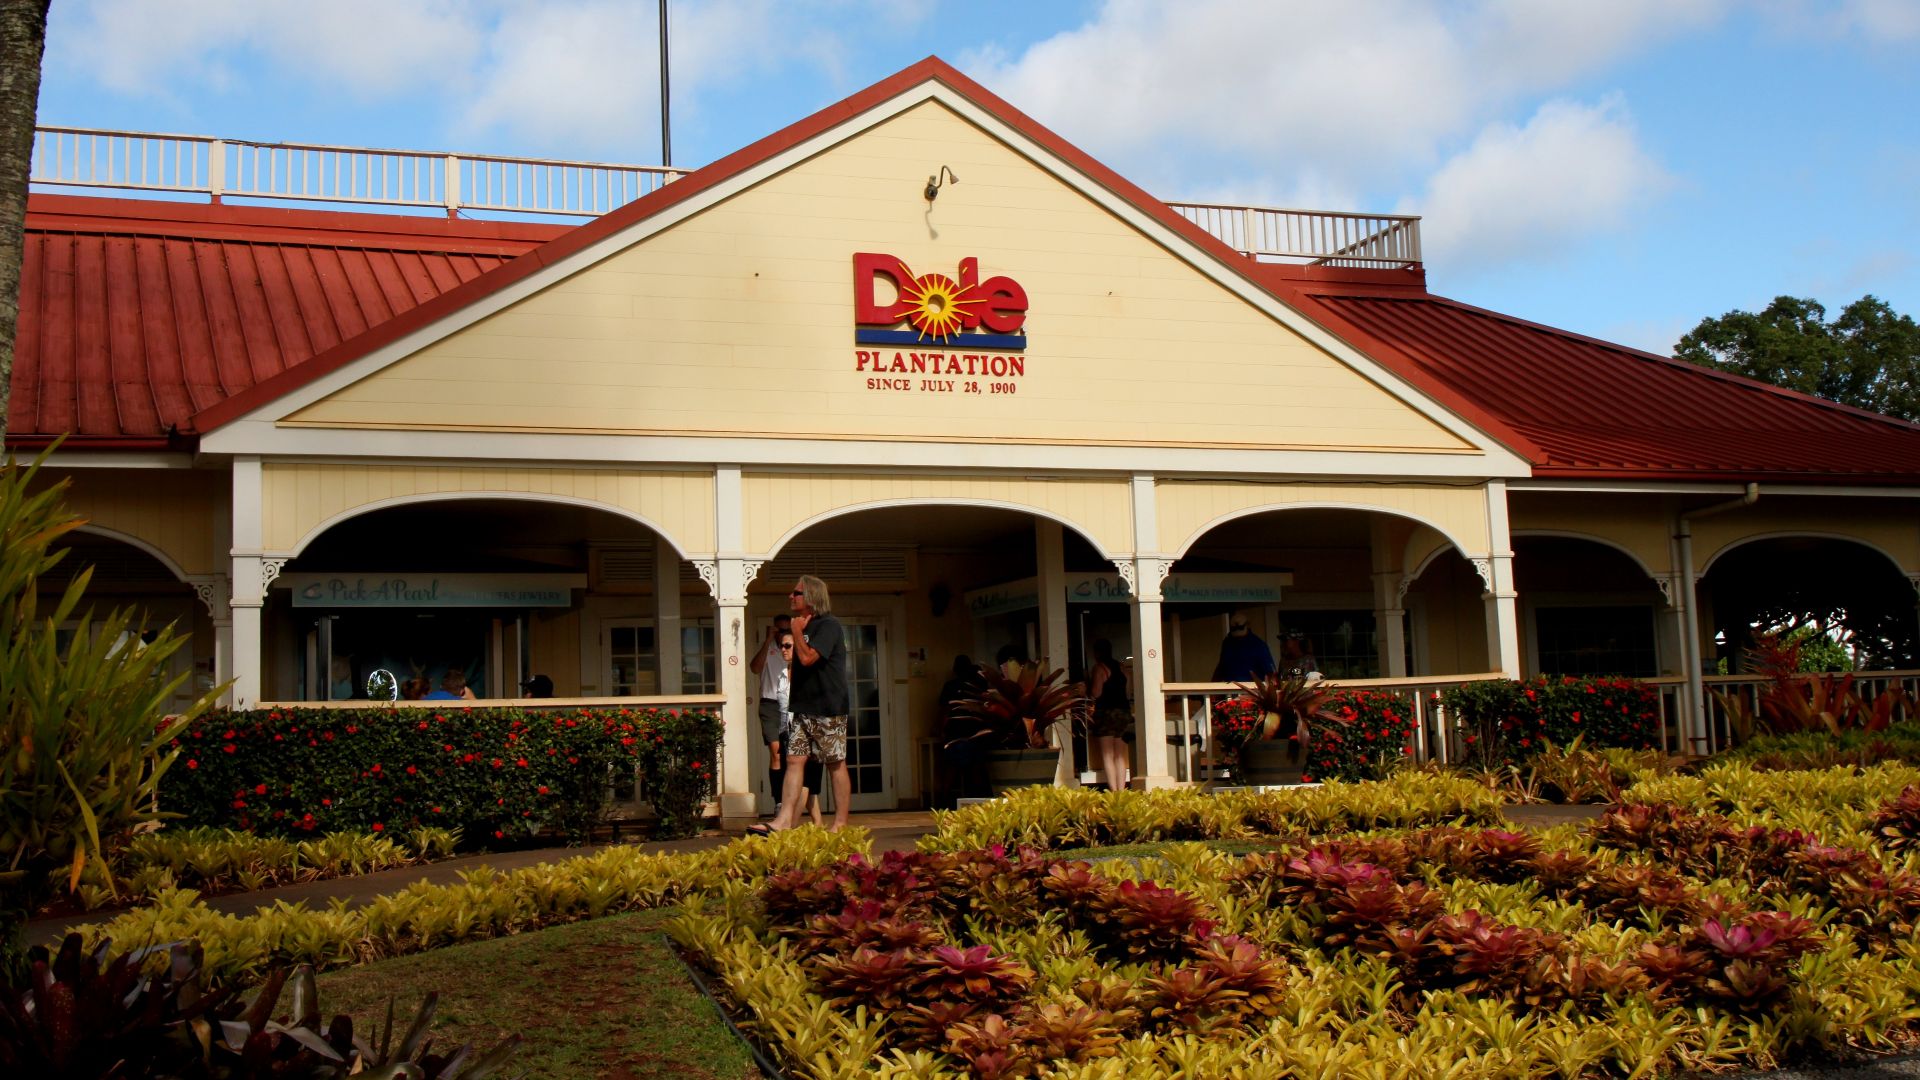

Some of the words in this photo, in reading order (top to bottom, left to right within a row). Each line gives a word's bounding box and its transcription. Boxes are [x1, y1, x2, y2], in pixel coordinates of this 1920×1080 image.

[853, 252, 1029, 335] Dole
[855, 350, 1025, 377] PLANTATION
[867, 378, 911, 391] SINCE
[920, 380, 955, 392] JULY
[964, 381, 982, 394] 28,
[990, 382, 1016, 394] 1900
[328, 578, 368, 600] Pick
[368, 580, 391, 600] A
[391, 579, 439, 600] Pearl
[1095, 577, 1125, 597] Pick
